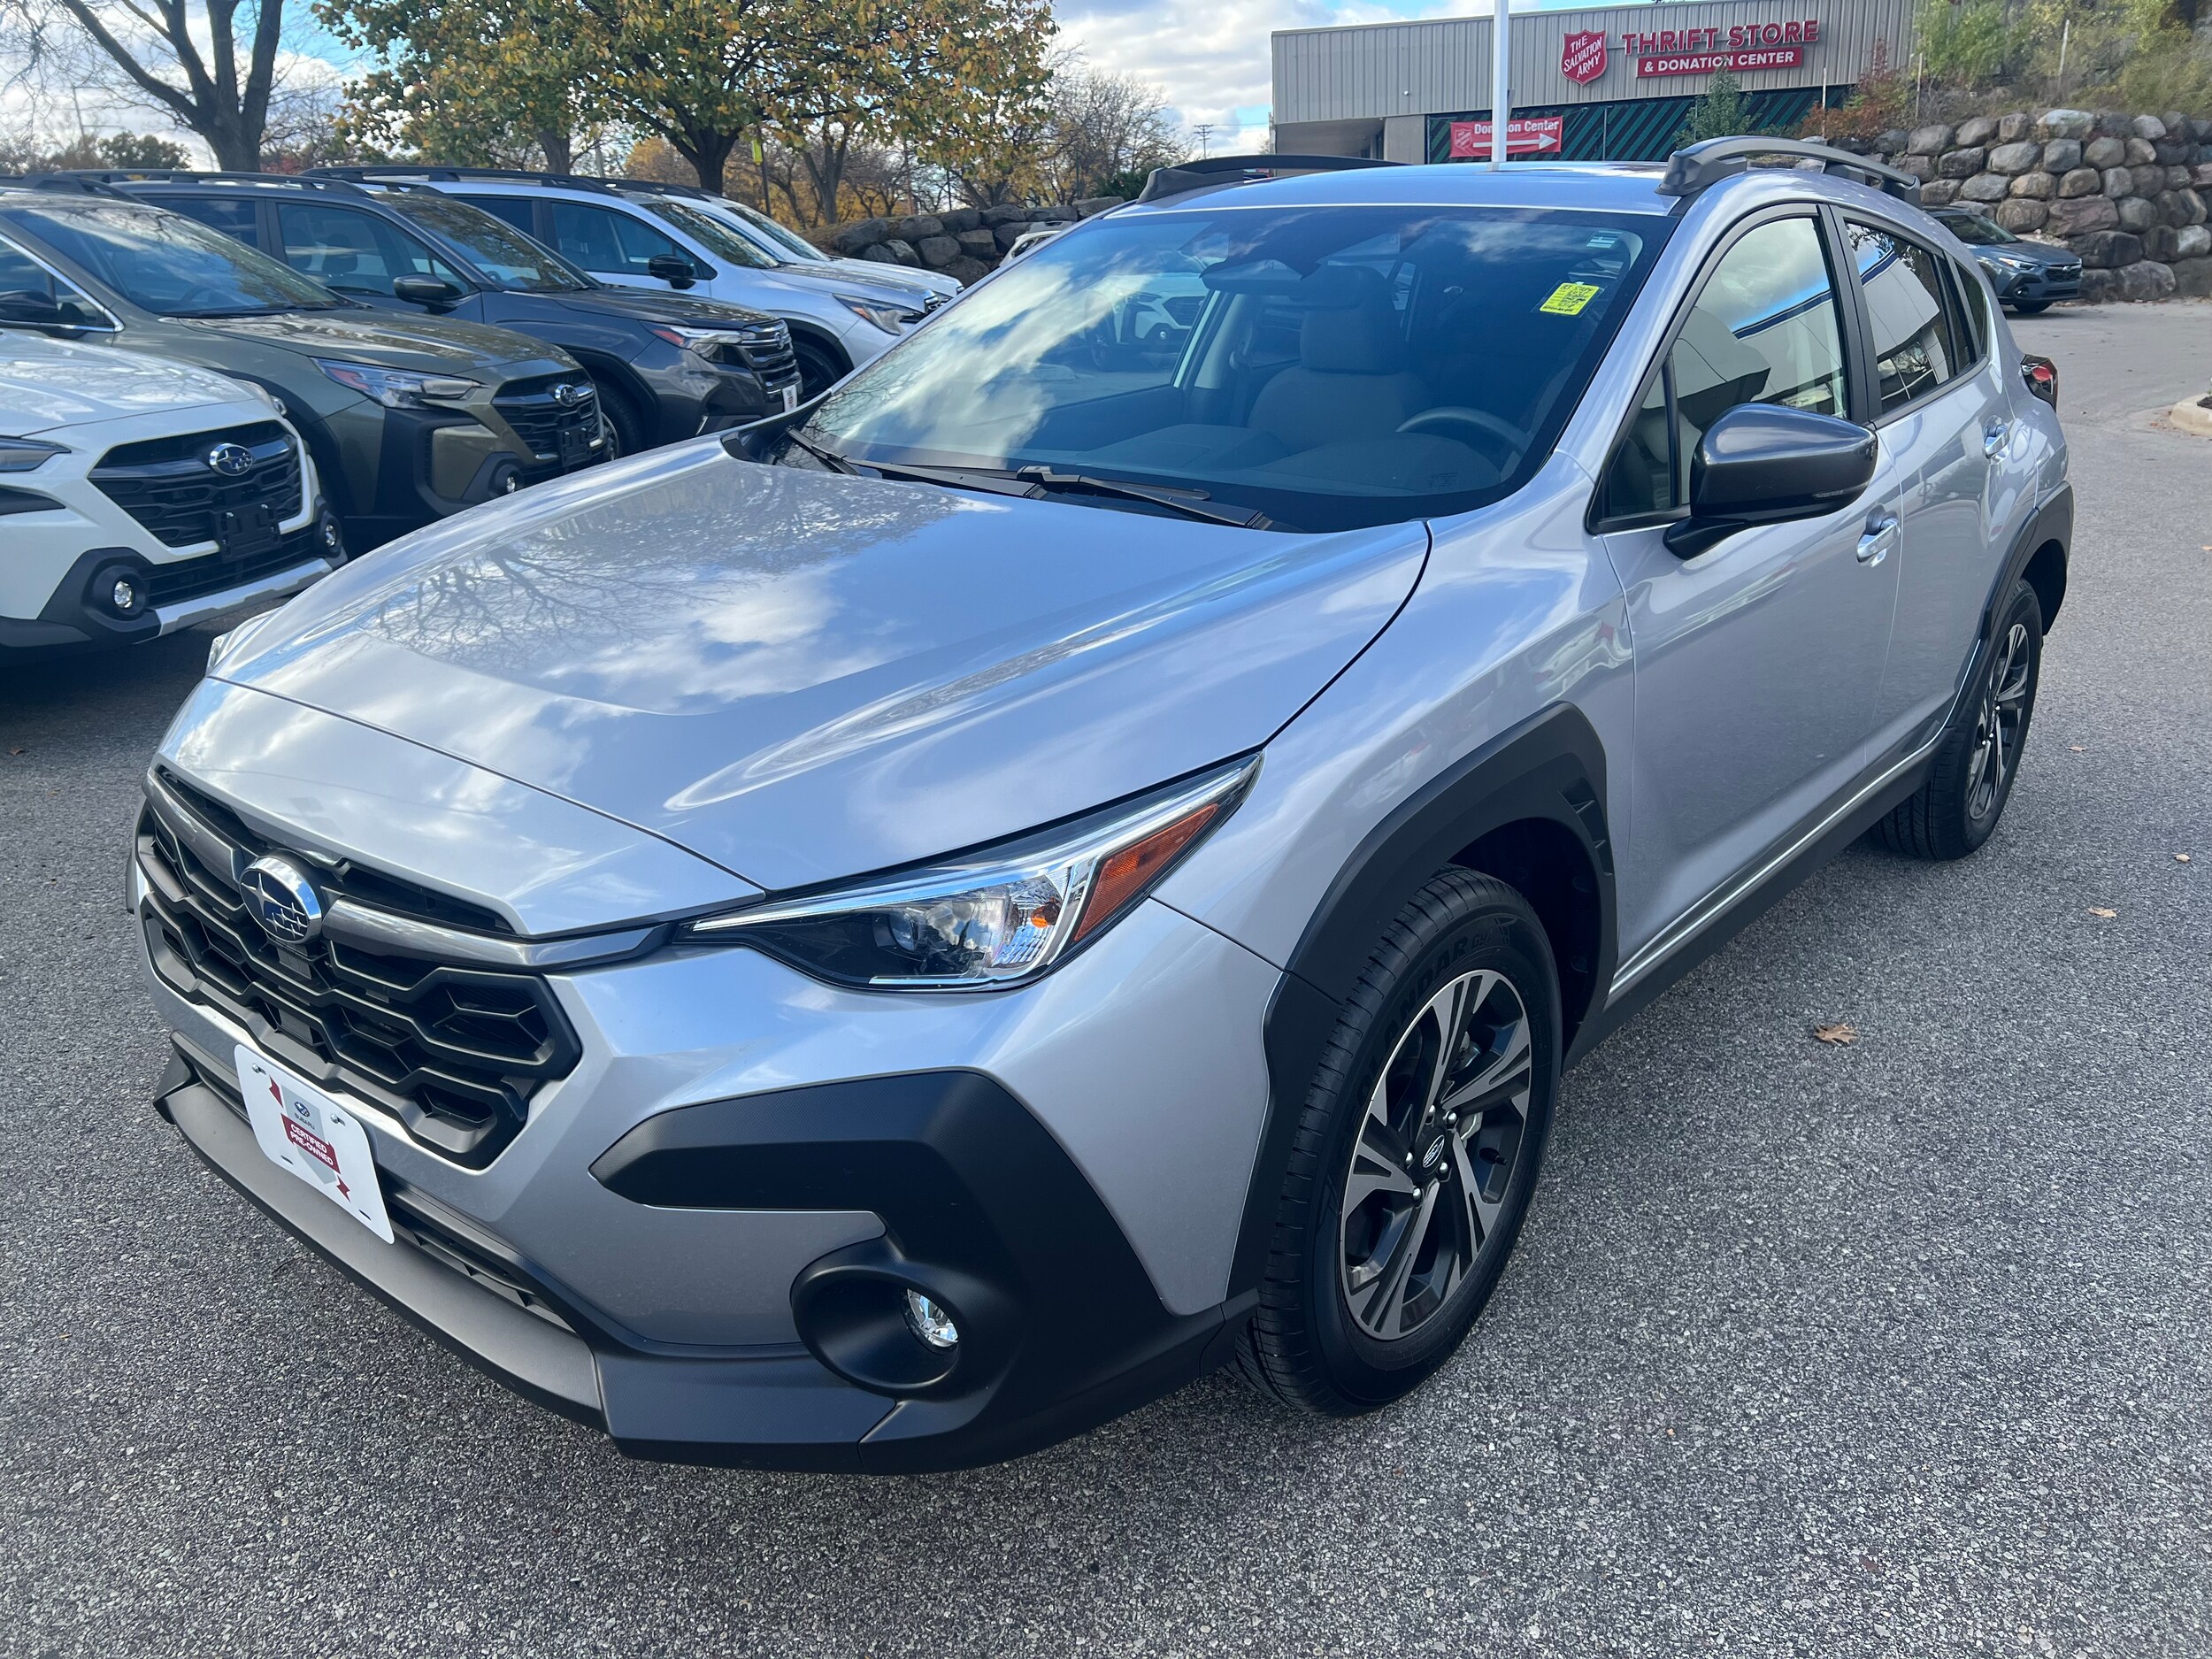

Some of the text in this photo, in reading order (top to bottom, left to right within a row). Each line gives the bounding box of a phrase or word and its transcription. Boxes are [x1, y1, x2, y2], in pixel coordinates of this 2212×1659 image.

[1571, 35, 1588, 53] THE
[1621, 19, 1819, 56] THRIFT STORE
[1563, 36, 1602, 72] SALVATION
[1576, 51, 1601, 78] ARMY
[1644, 51, 1794, 73] & DONATION CENTER
[1474, 120, 1560, 134] Donon Center
[290, 1131, 334, 1166] PRE-OWNED
[291, 1124, 327, 1153] CERTIFIED
